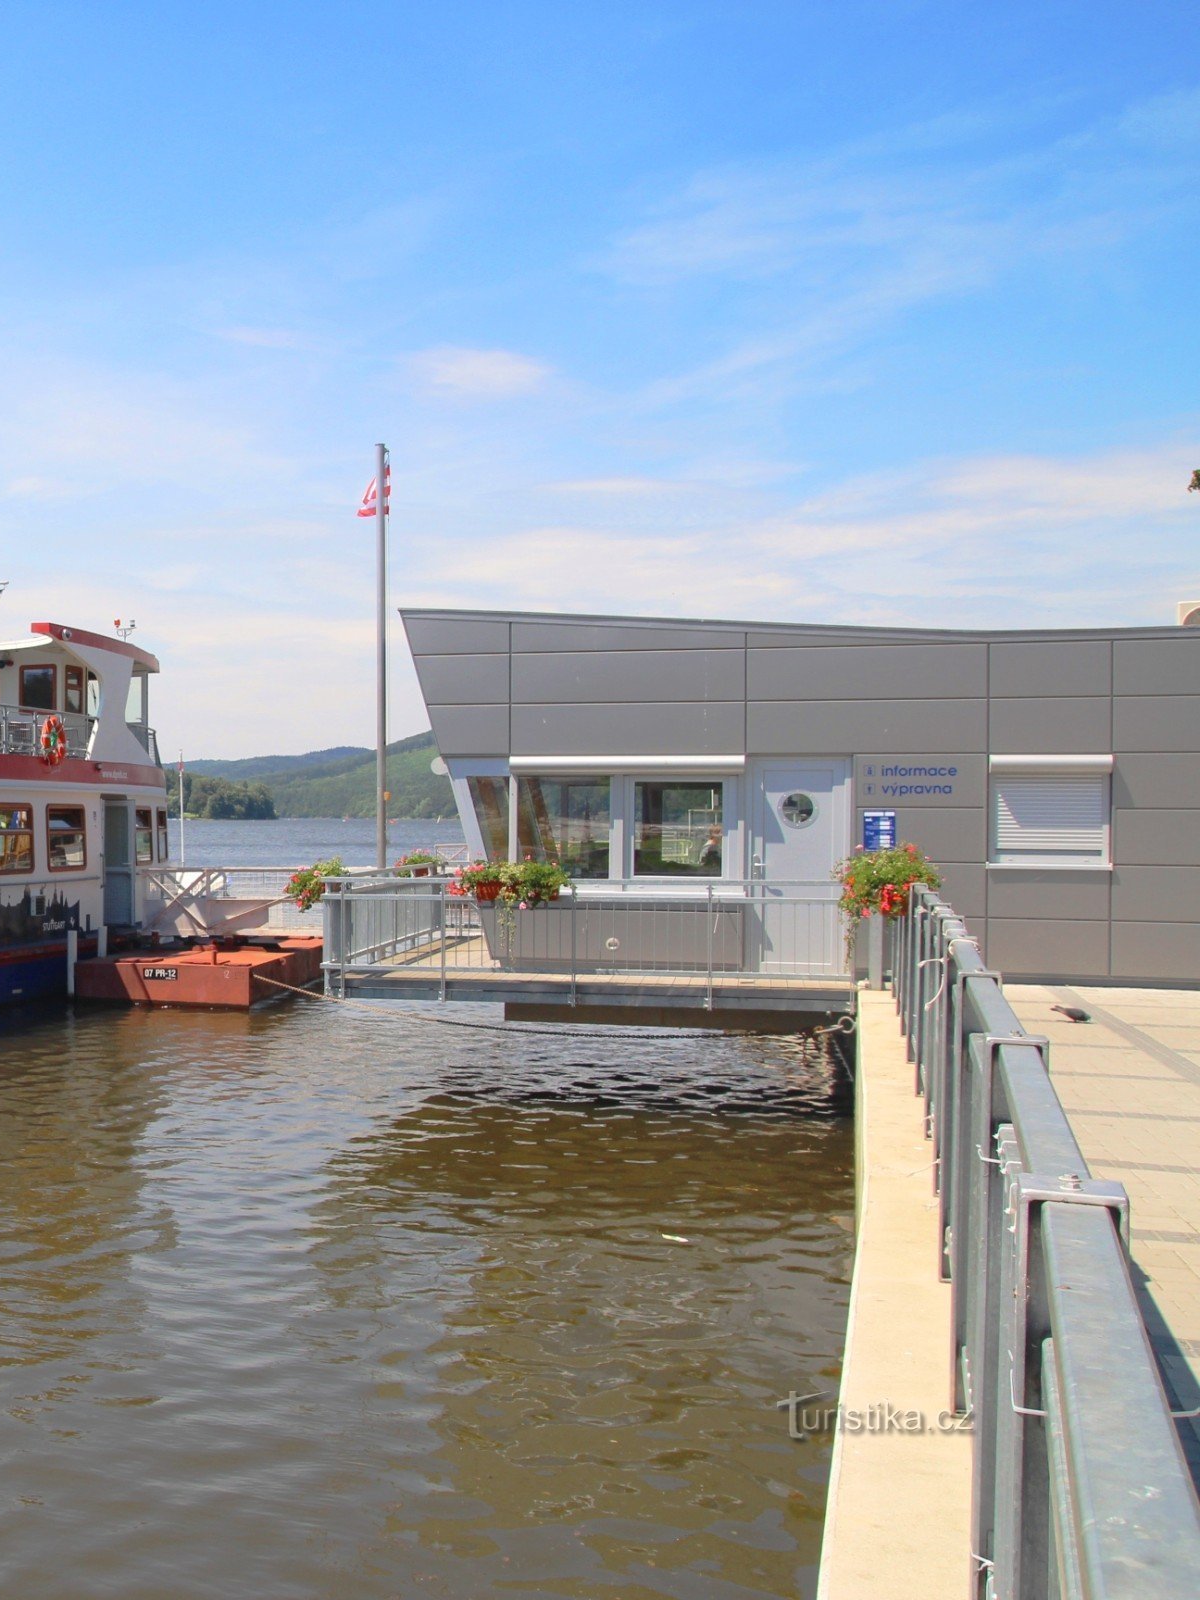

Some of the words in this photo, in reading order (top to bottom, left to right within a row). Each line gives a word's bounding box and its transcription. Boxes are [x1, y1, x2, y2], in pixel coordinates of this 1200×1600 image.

[881, 765, 958, 777] informace
[881, 782, 952, 796] výpravna
[144, 968, 153, 978] 07
[155, 968, 176, 978] PR-12
